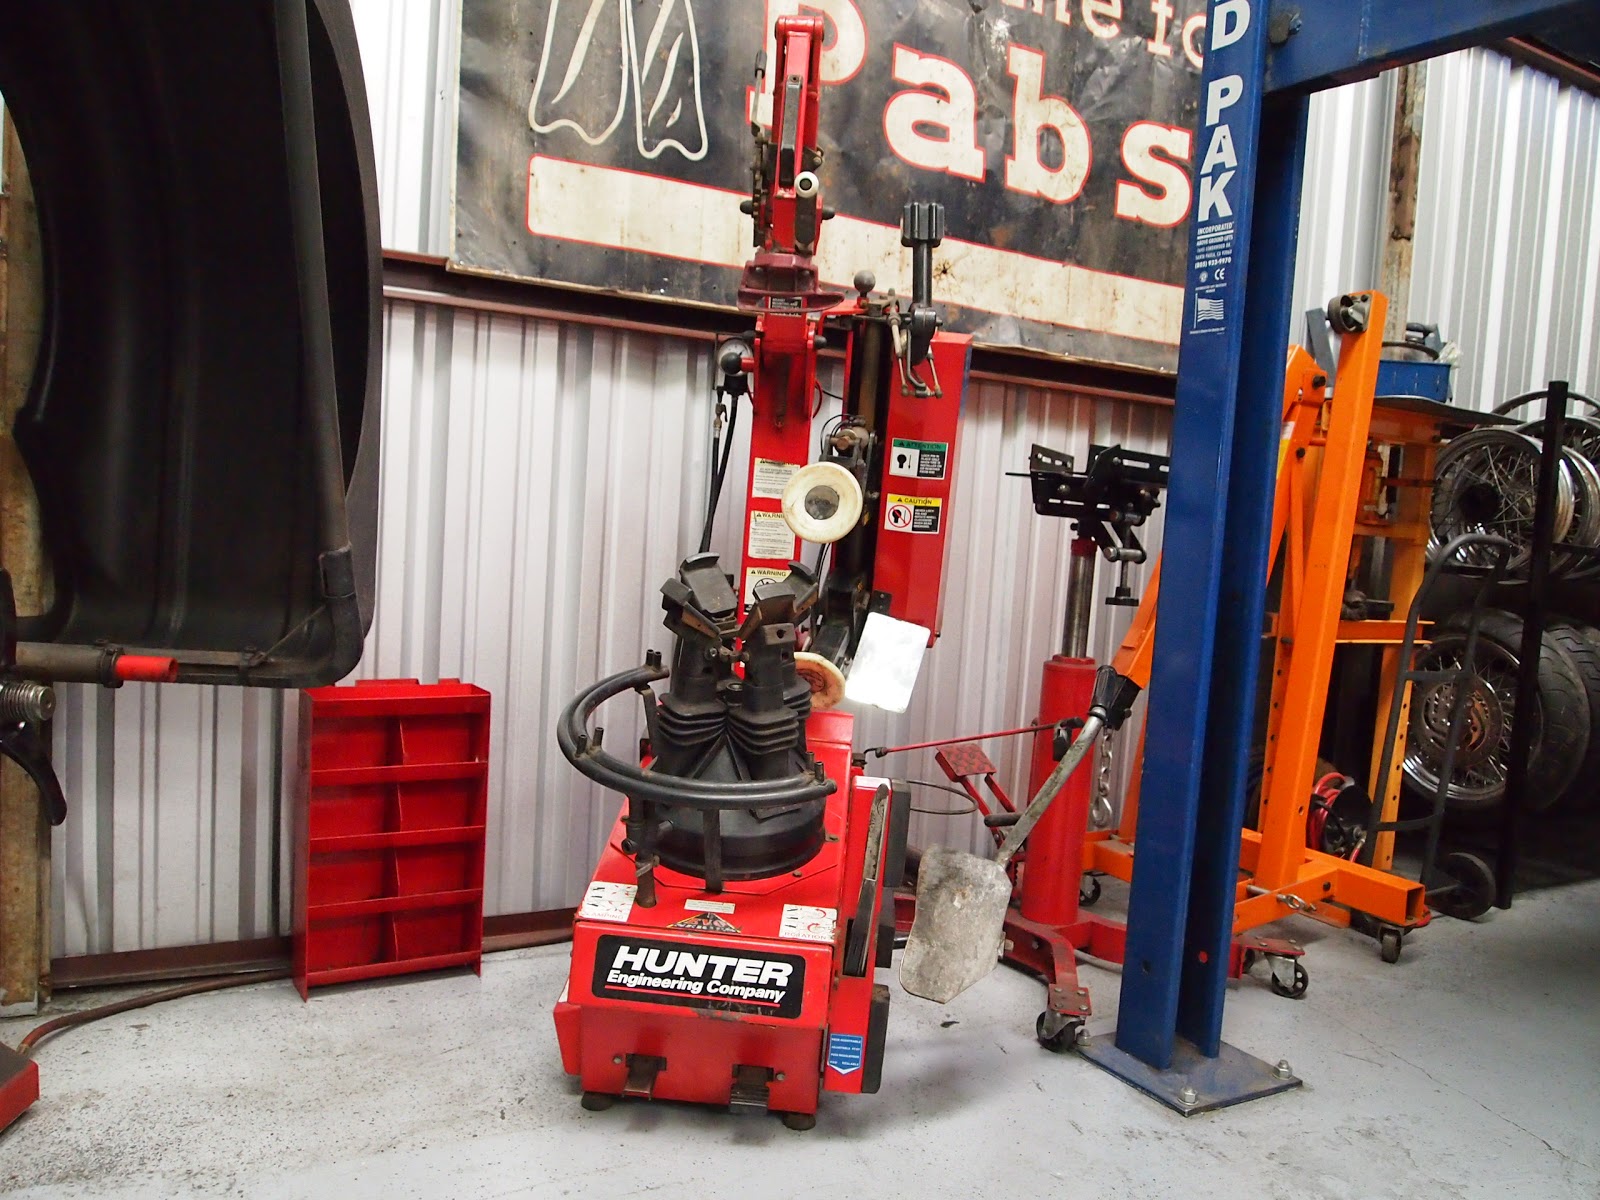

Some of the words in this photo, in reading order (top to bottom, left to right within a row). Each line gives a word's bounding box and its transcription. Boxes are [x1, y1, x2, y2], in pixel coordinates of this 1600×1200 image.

[1211, 0, 1251, 51] D
[1197, 74, 1244, 222] PAK
[1197, 222, 1234, 235] INCORPORATED
[904, 497, 933, 505] CAUTION
[757, 569, 787, 577] WARNING
[611, 945, 793, 987] HUNTER
[606, 969, 702, 995] Engineering
[706, 979, 786, 1003] Company
